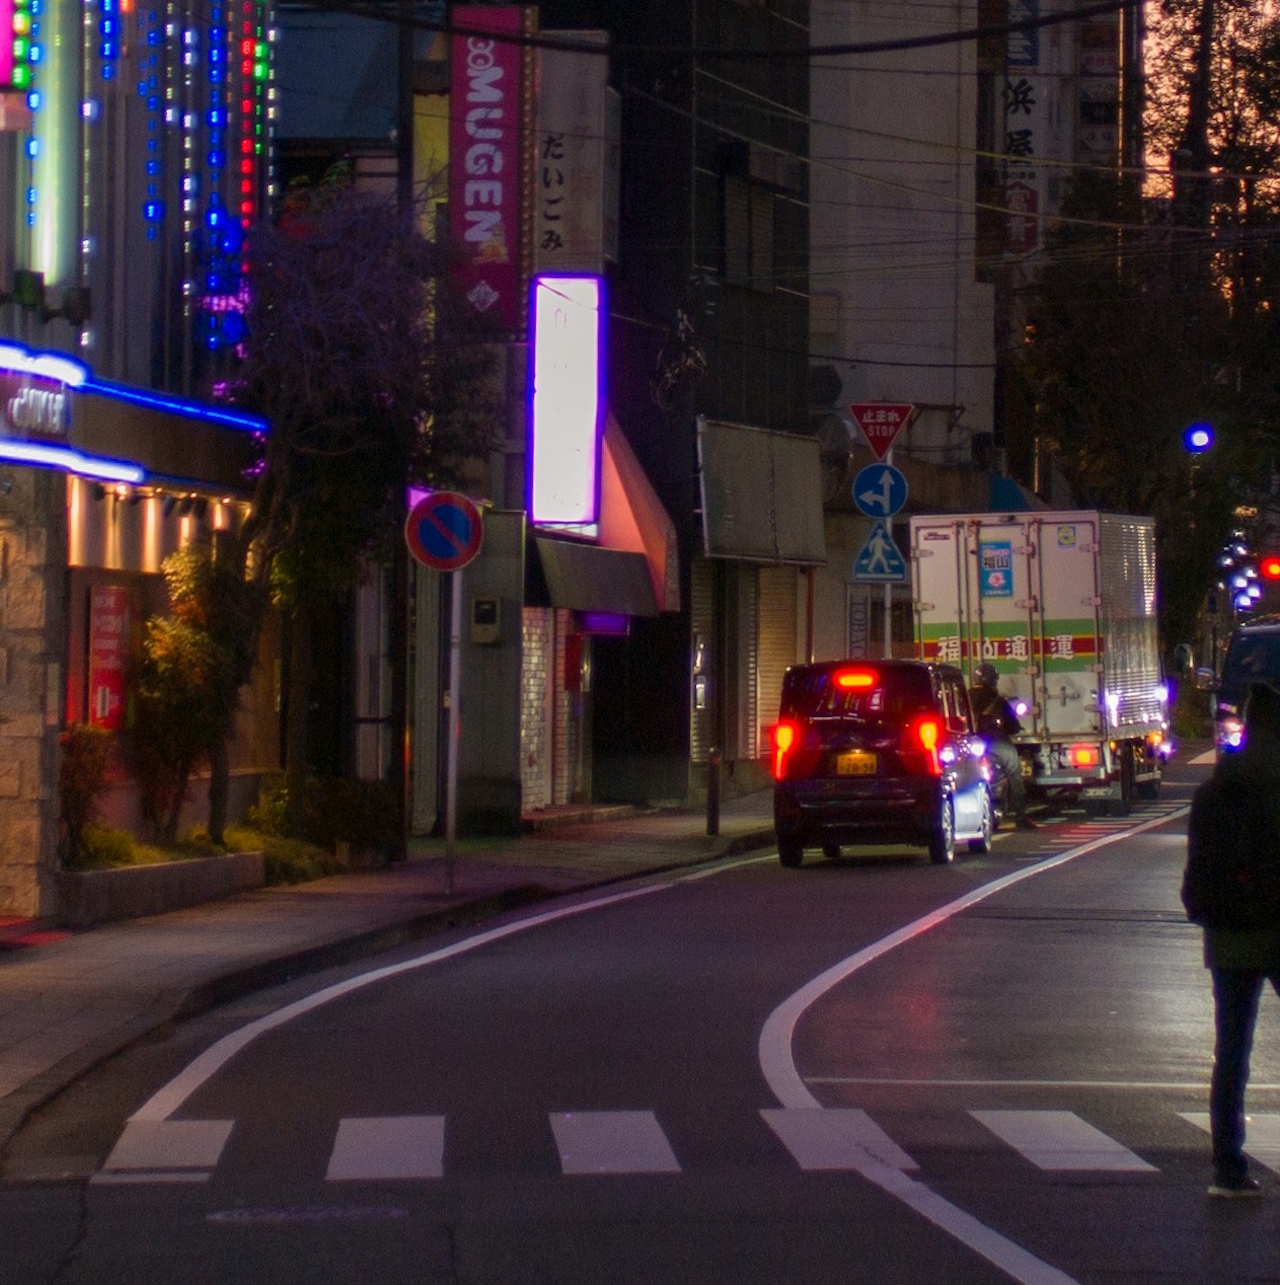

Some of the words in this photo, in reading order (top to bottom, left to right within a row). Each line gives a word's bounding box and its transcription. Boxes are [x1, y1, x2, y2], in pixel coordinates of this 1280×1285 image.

[463, 65, 505, 243] MUGEN
[540, 134, 564, 252] だいごみ
[862, 409, 901, 423] 止まれ
[867, 424, 896, 437] STOP
[937, 634, 1075, 662] 福山通運
